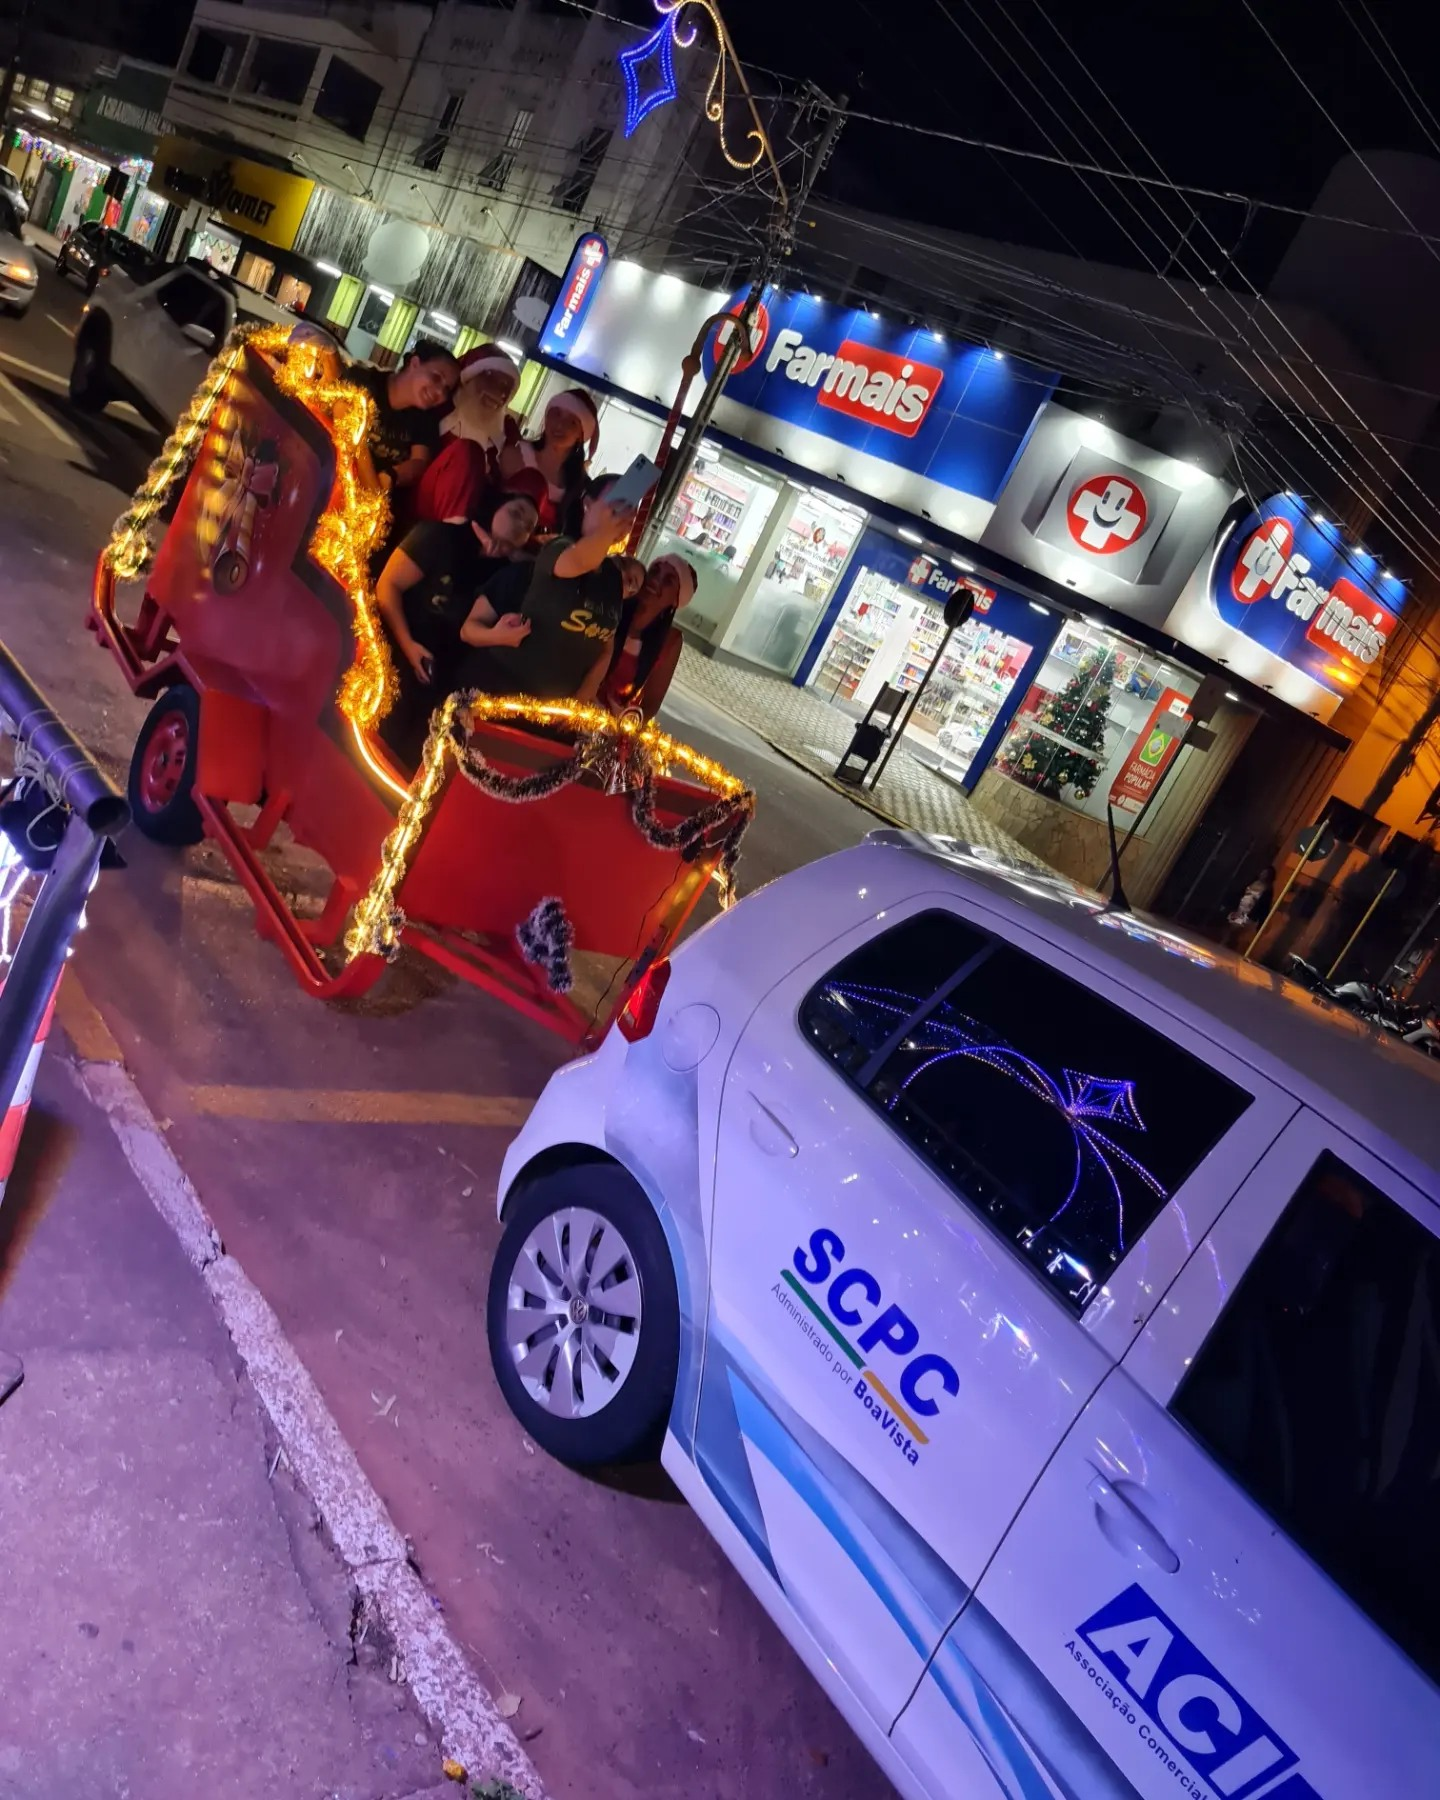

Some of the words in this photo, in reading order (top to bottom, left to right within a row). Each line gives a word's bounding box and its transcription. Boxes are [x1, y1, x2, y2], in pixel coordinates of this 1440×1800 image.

[553, 267, 592, 338] Farmais
[765, 328, 929, 423] Farmais
[1270, 553, 1387, 664] Farmais
[1124, 772, 1151, 791] POPULAR
[771, 1282, 834, 1363] Administrado
[832, 1361, 853, 1385] por
[853, 1379, 919, 1467] BoaVista
[793, 1228, 960, 1417] SCPC
[1064, 1640, 1137, 1725] Associação
[1138, 1724, 1208, 1800] Comercial
[1086, 1615, 1285, 1797] ACI
